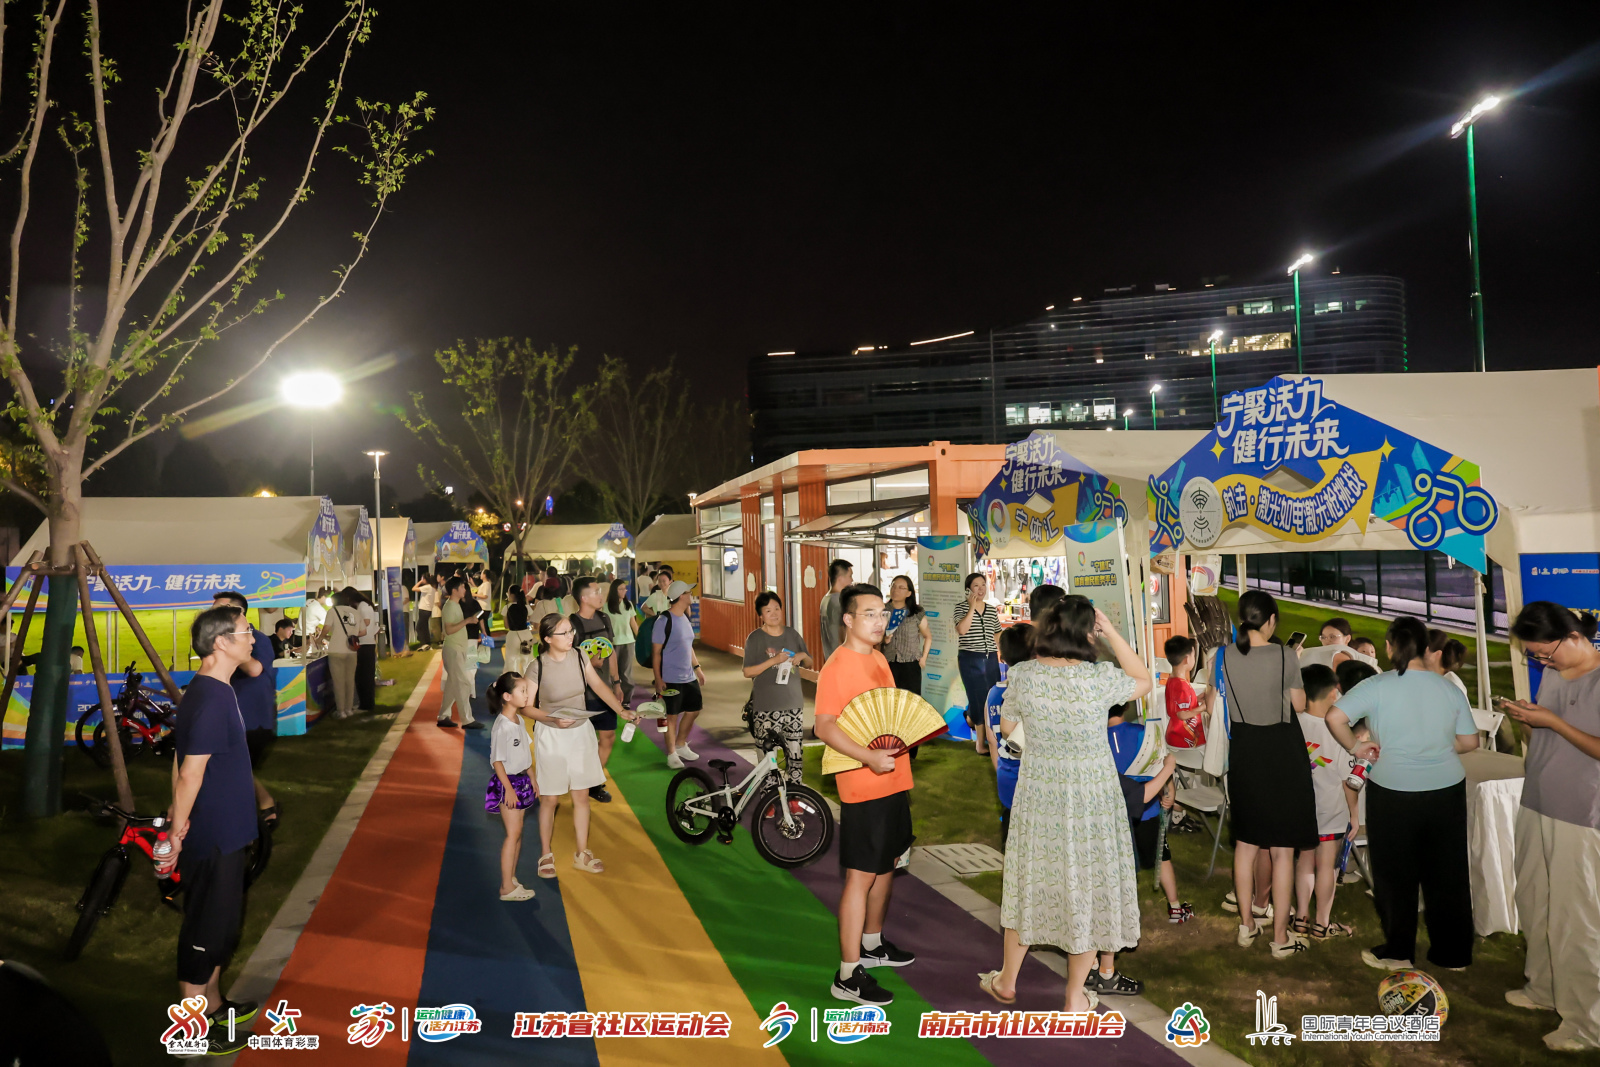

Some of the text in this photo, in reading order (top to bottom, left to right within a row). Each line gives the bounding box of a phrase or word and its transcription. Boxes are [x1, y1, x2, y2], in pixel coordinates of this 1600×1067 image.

[1217, 378, 1336, 439] 宁聚活力
[1002, 432, 1062, 476] 宁聚活力
[1232, 417, 1350, 471] 健行未来
[1011, 460, 1067, 497] 健行未来
[1014, 508, 1060, 543] 宁体汇
[164, 573, 247, 594] 健行未来
